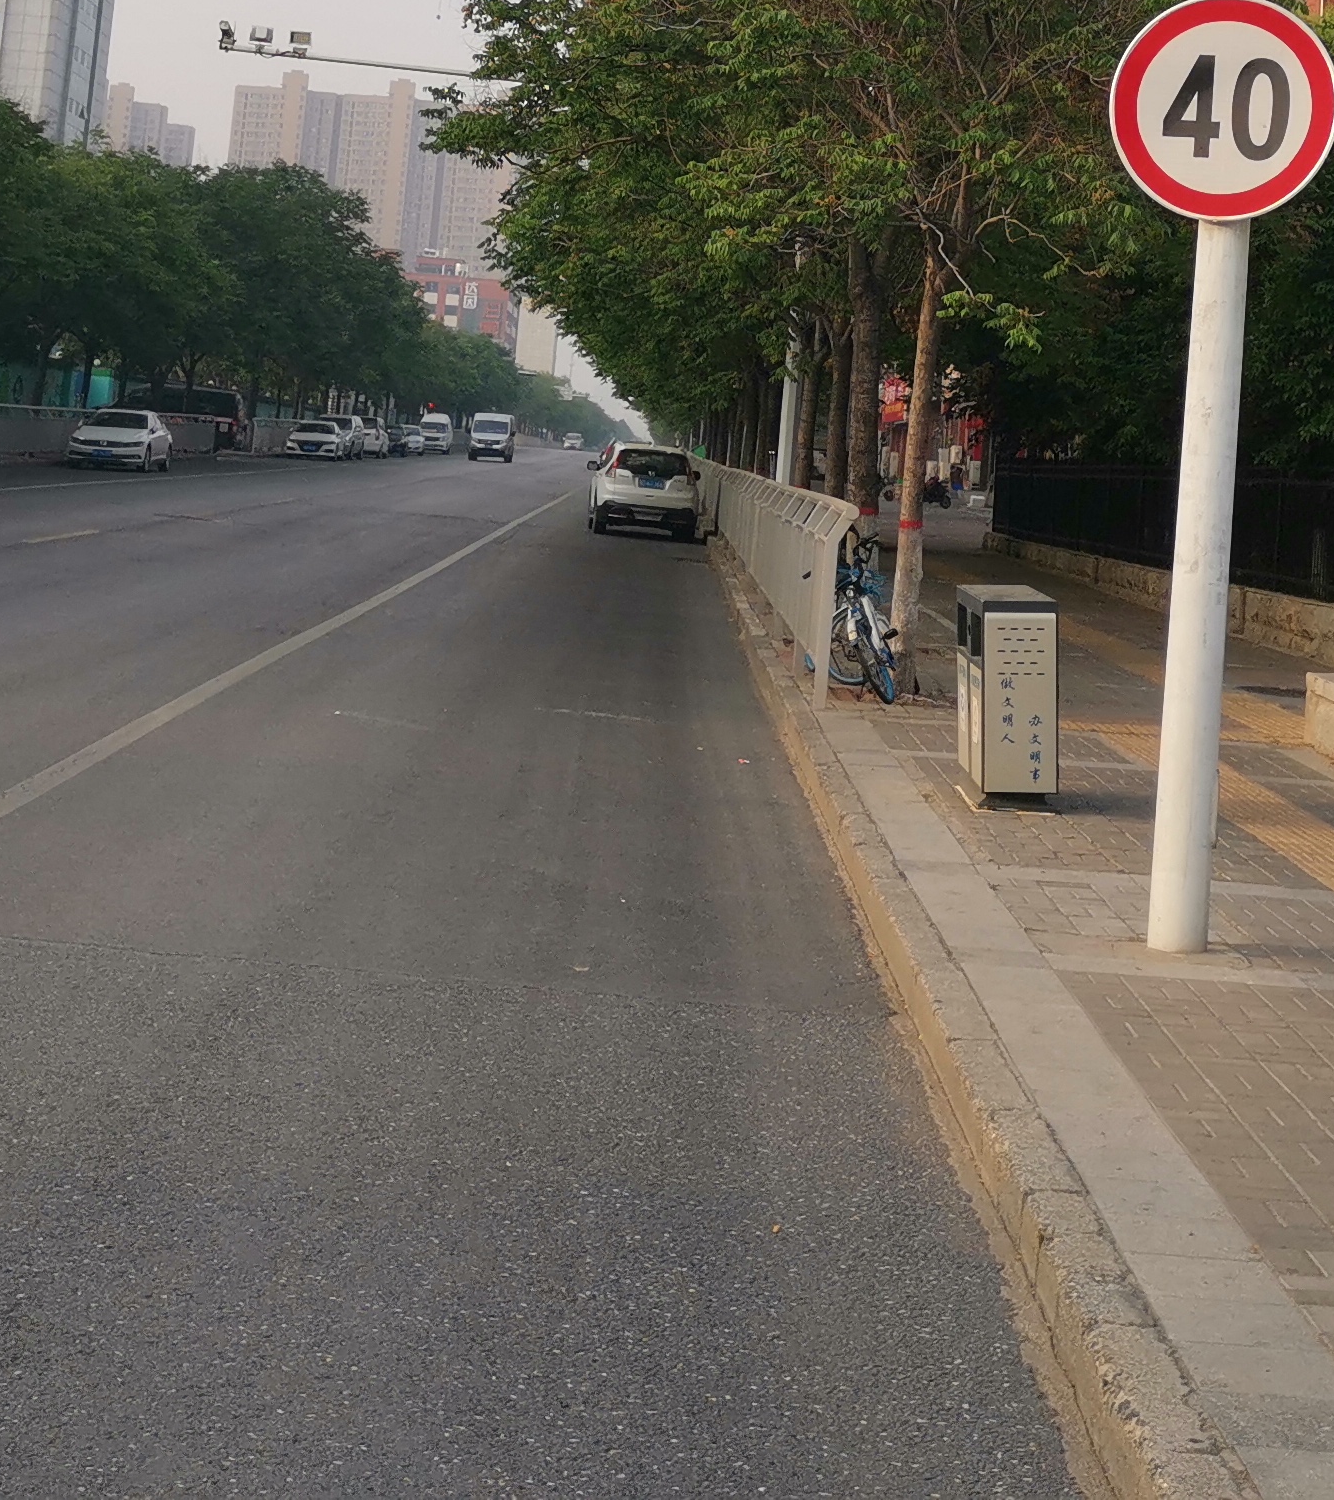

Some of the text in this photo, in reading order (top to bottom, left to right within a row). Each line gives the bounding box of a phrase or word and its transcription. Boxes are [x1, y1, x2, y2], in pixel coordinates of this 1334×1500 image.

[1162, 54, 1291, 162] 40
[1001, 677, 1015, 744] 做文明人
[1029, 714, 1043, 783] 办文明事
